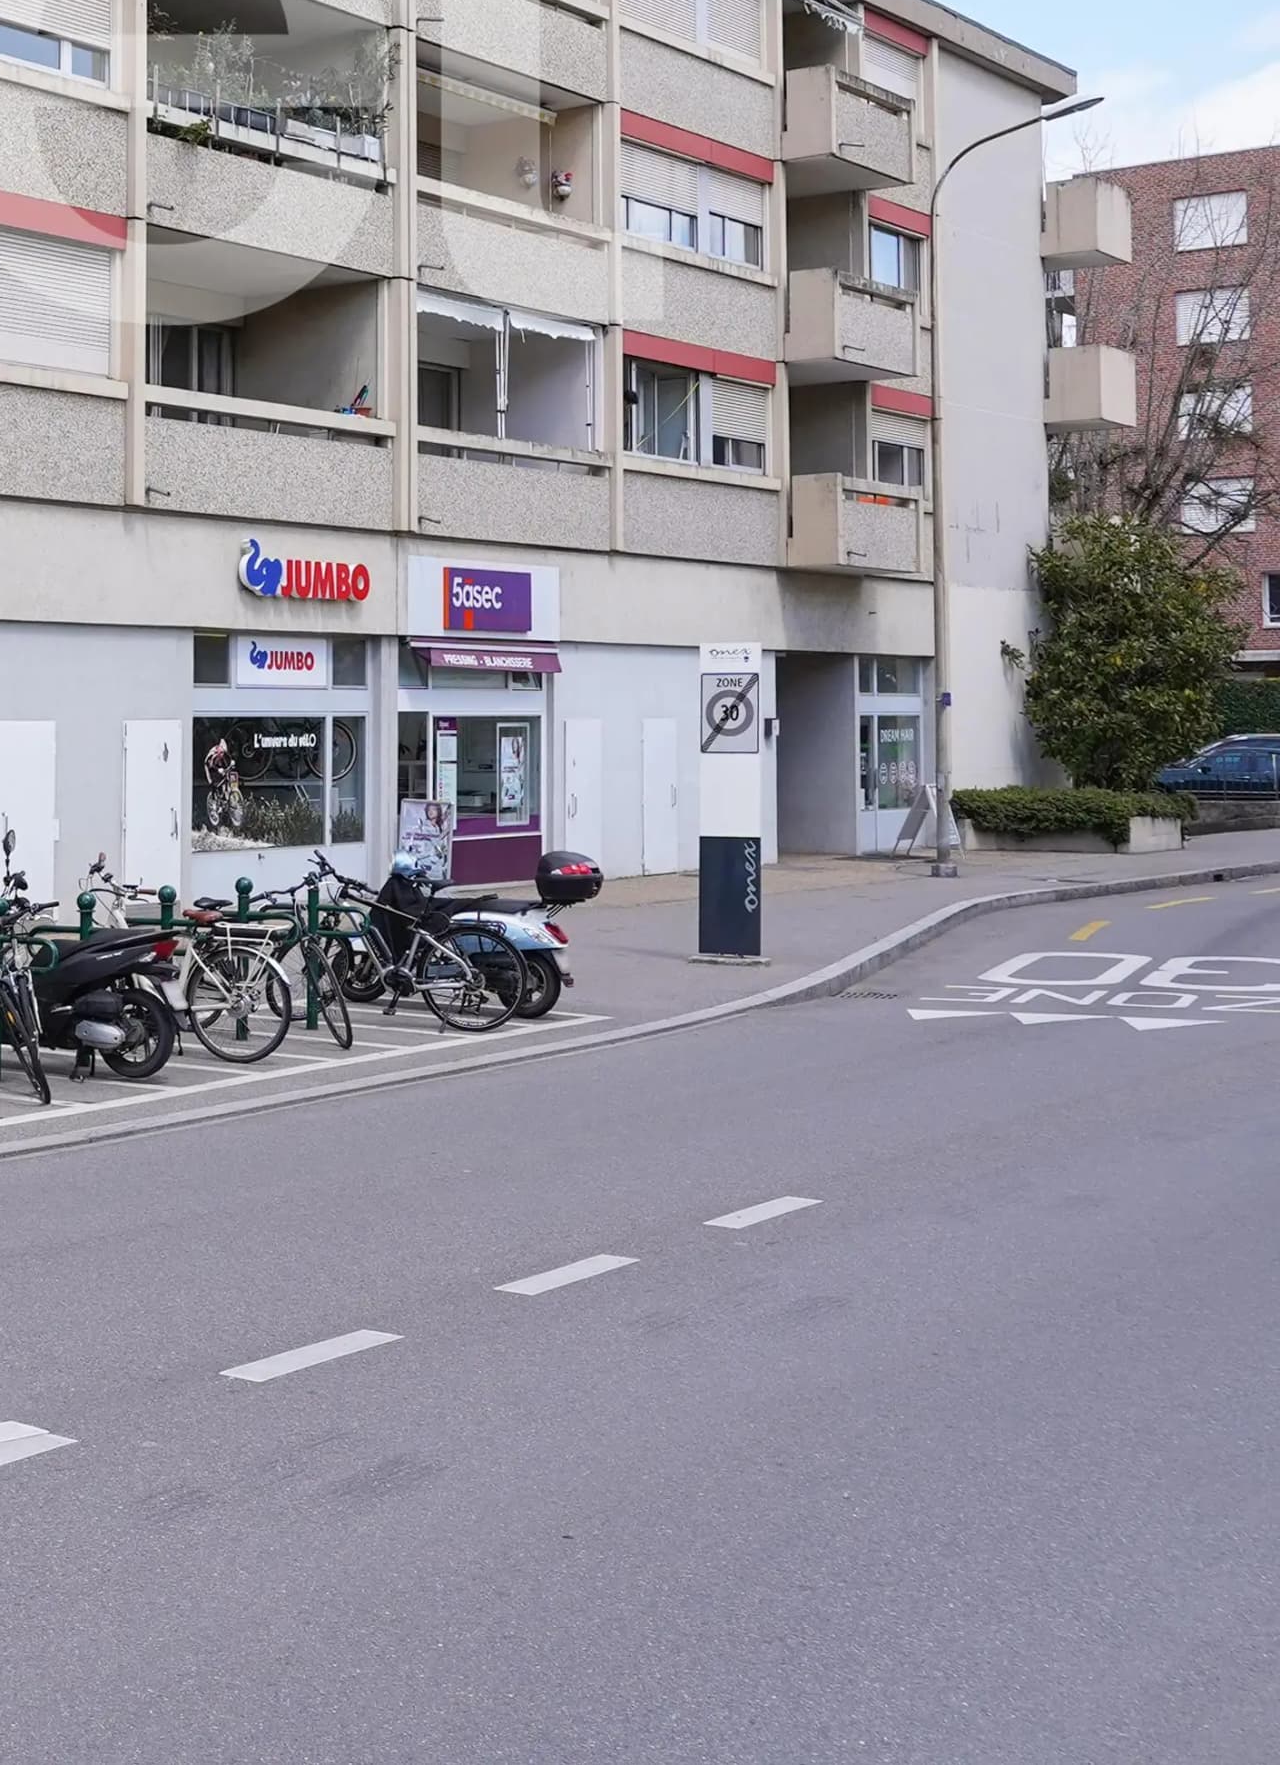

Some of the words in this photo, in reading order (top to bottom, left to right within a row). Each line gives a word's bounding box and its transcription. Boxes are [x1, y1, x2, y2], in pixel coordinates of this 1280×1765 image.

[281, 559, 371, 601] JUMBO
[267, 651, 315, 671] JUMBO
[716, 677, 743, 688] ZONE
[721, 704, 739, 721] 30
[744, 840, 759, 913] onex
